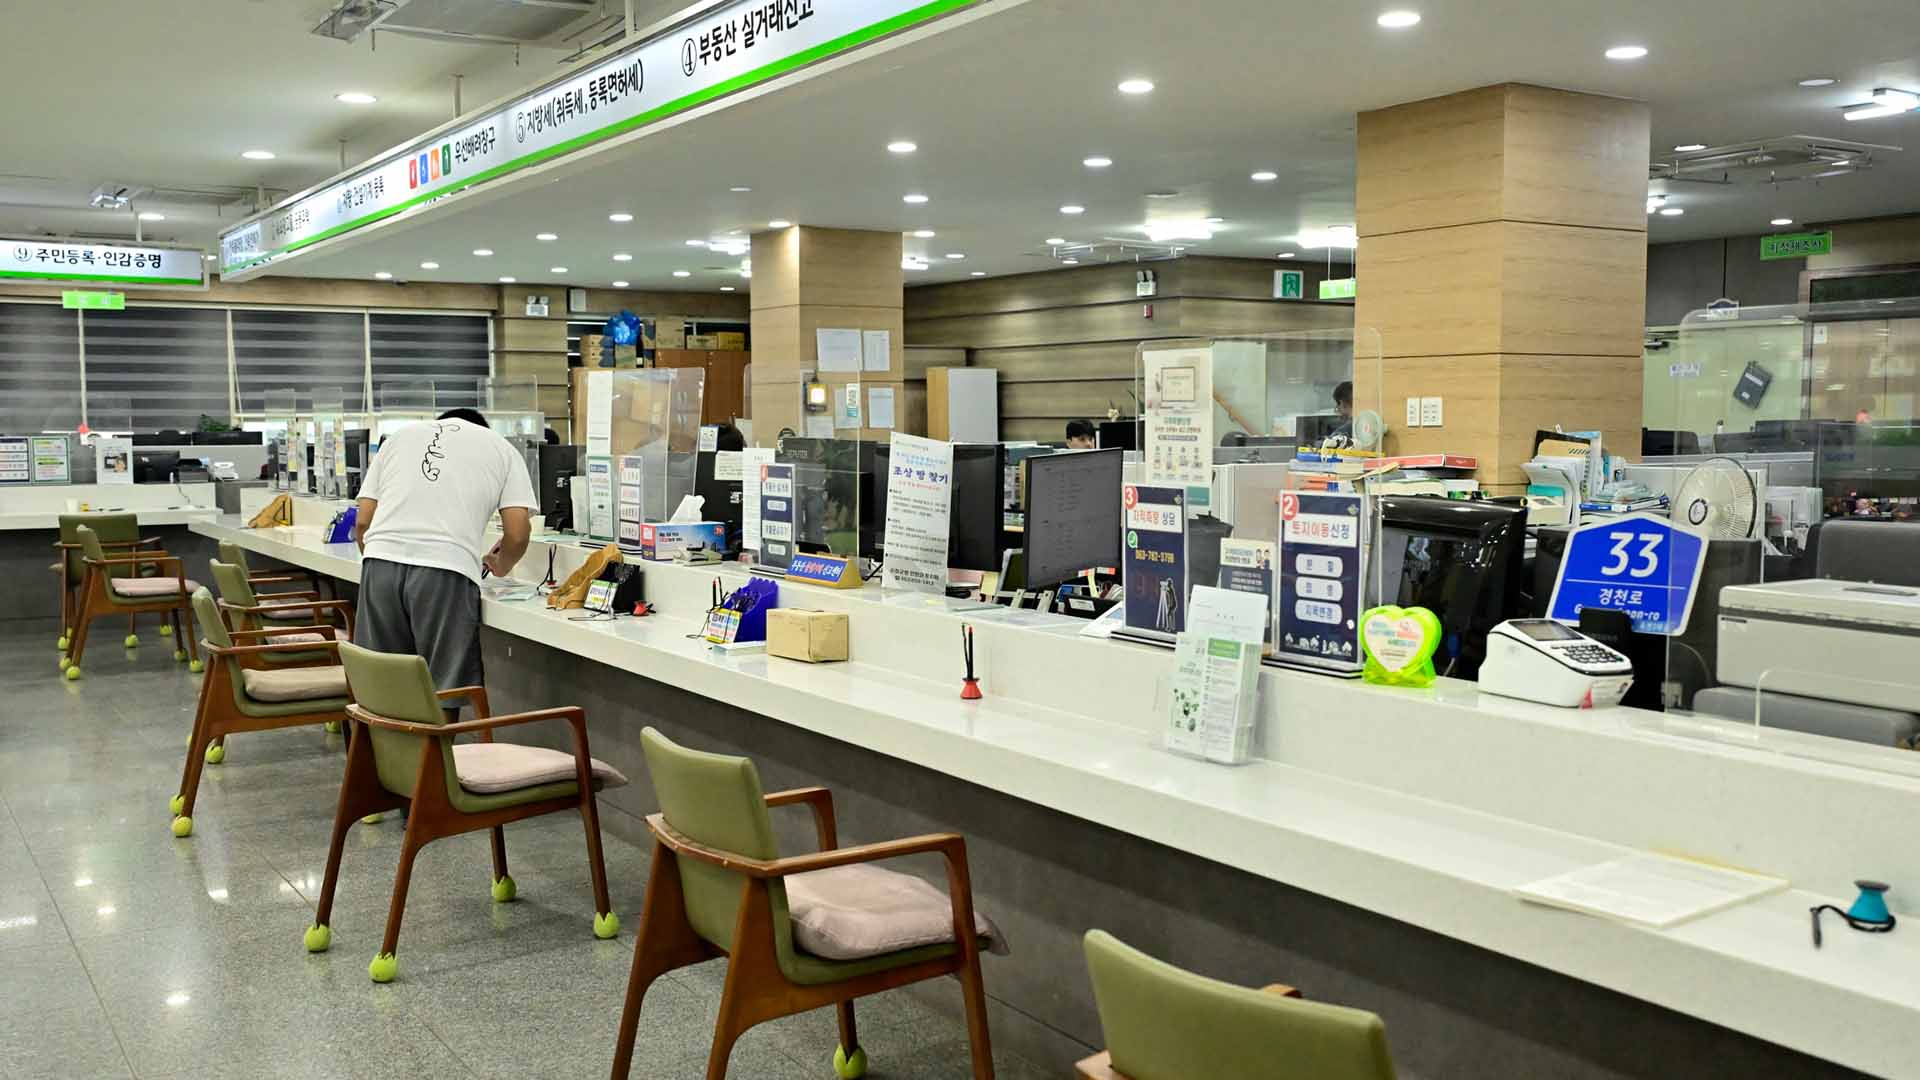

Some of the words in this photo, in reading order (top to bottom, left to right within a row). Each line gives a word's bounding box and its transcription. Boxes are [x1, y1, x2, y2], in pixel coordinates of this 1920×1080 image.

[699, 23, 736, 66] 부동산
[741, 0, 815, 49] 실거래신고
[455, 126, 495, 165] 우선배려창구
[35, 248, 161, 269] 주민등록·인감증명
[893, 466, 913, 478] 조상
[928, 472, 948, 485] 찾기
[1125, 487, 1134, 505] 3
[1284, 495, 1294, 516] 2
[1600, 532, 1664, 578] 33
[1599, 588, 1643, 606] 경천로
